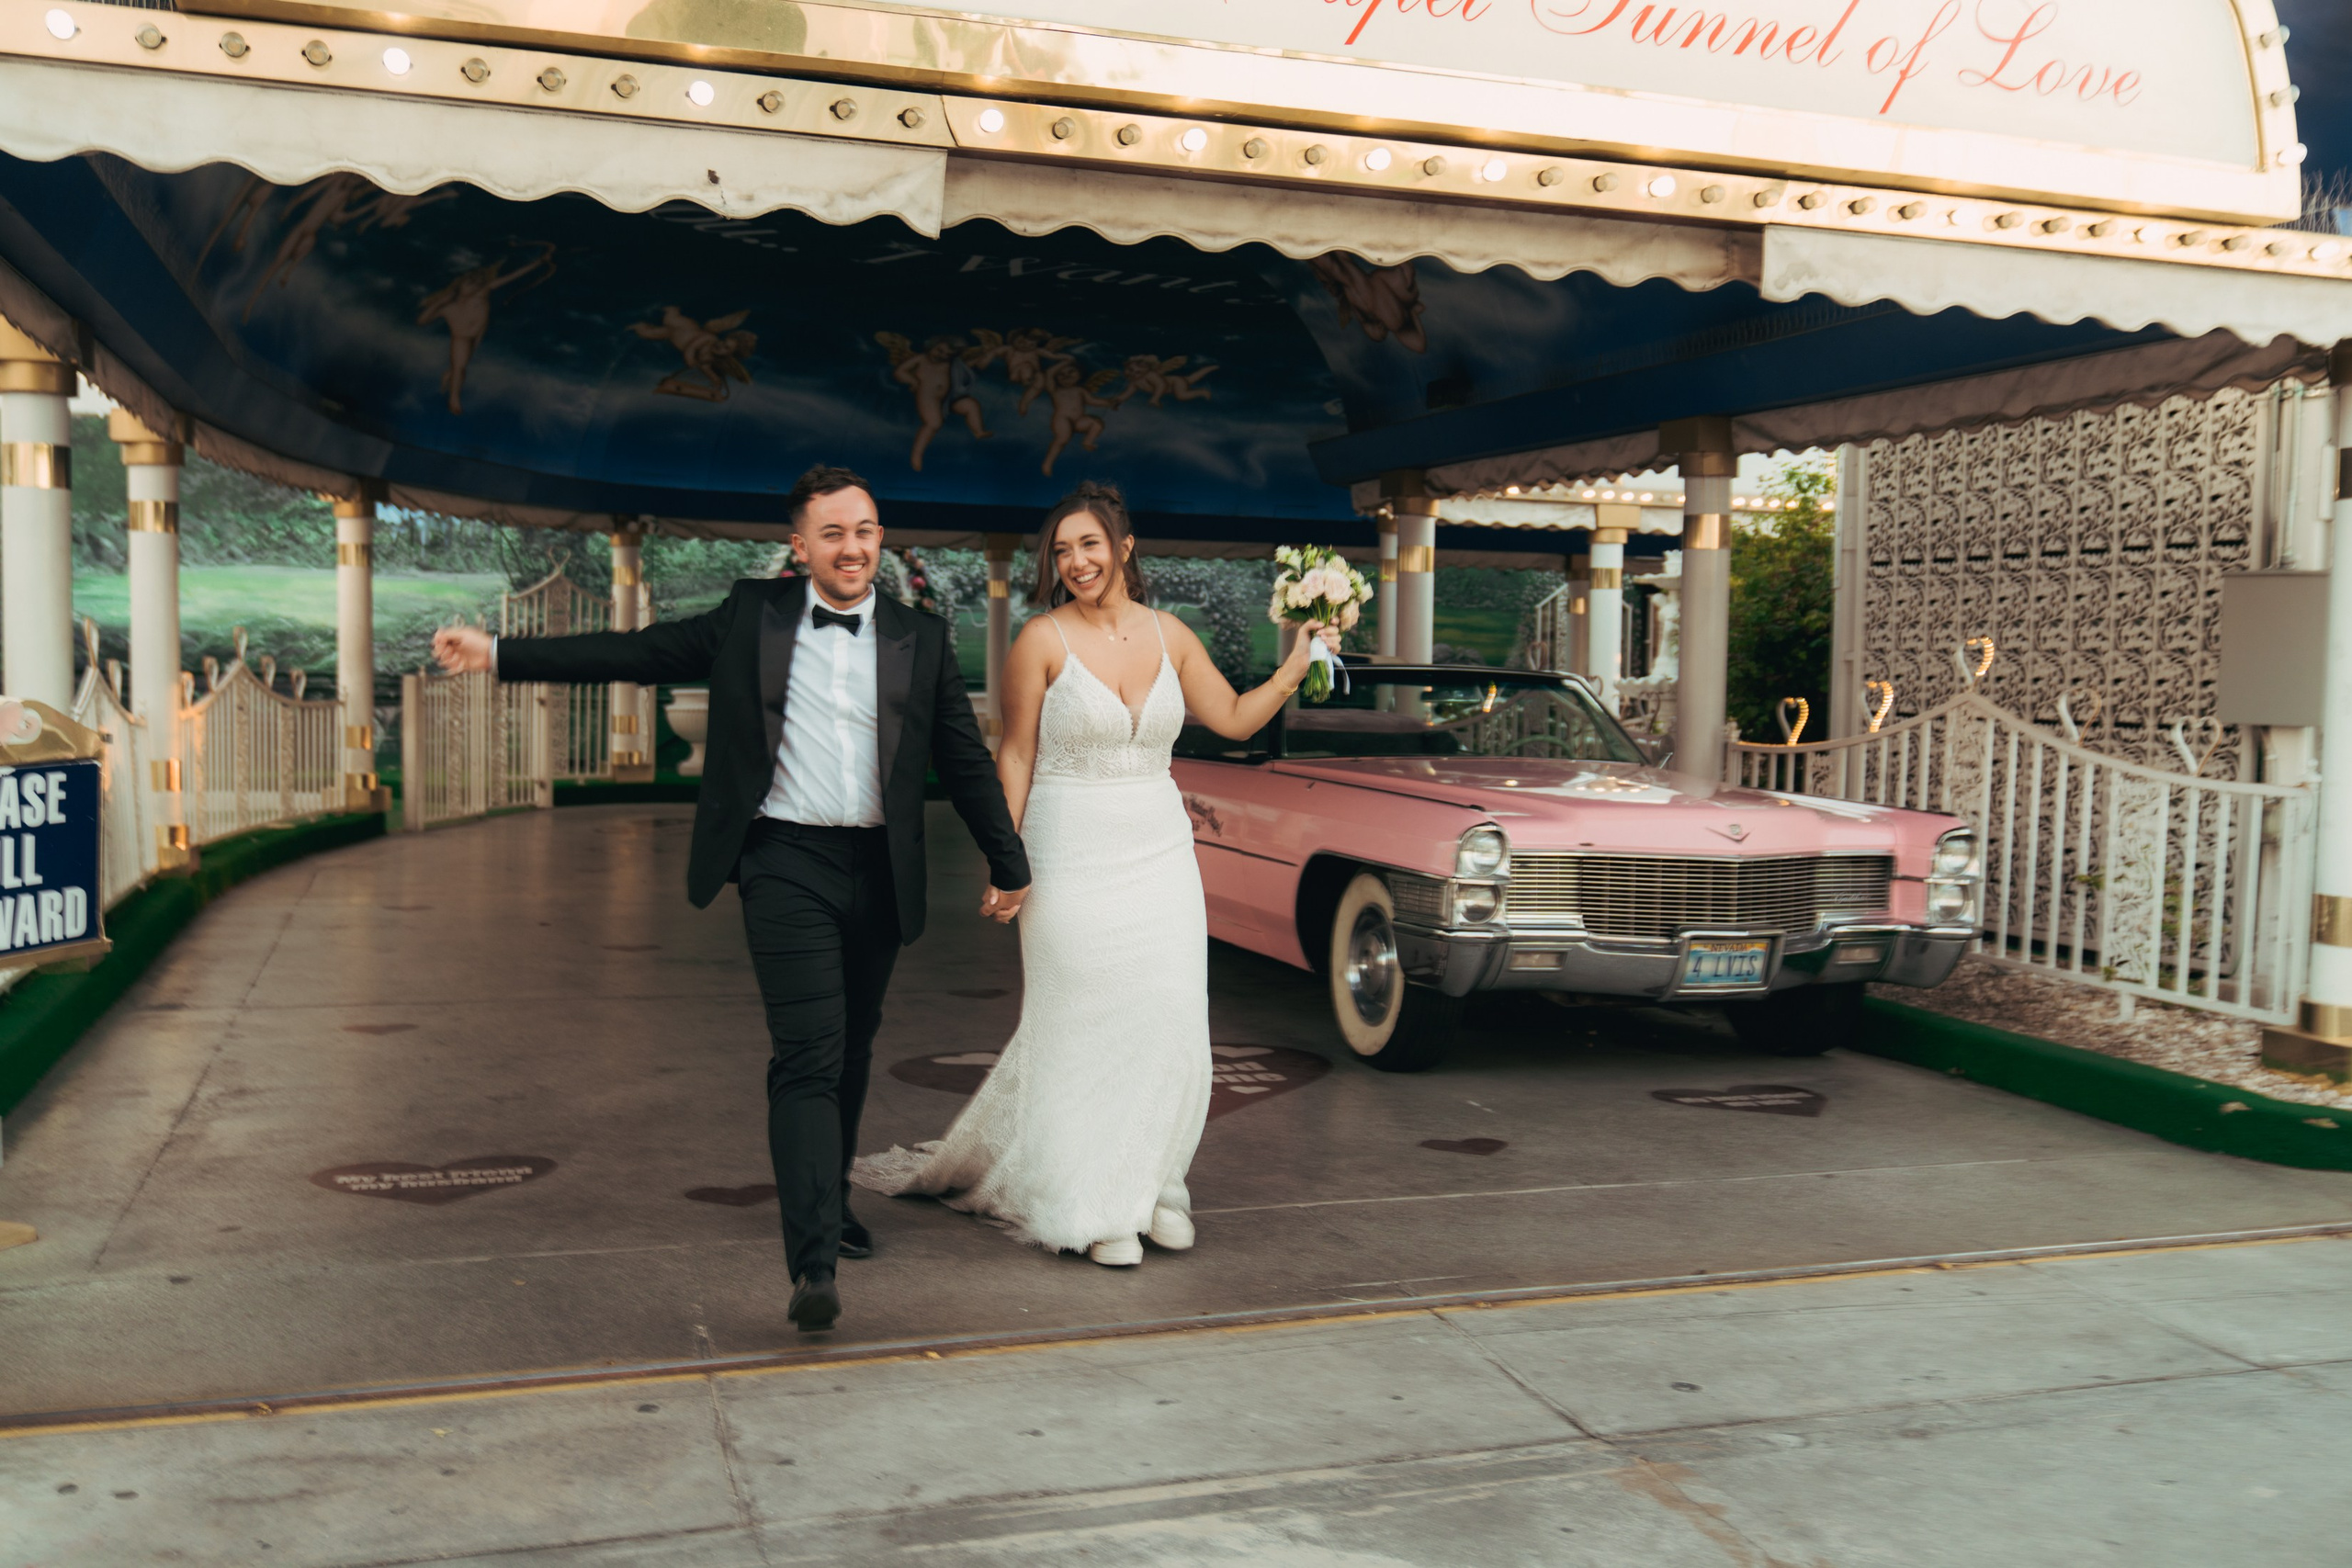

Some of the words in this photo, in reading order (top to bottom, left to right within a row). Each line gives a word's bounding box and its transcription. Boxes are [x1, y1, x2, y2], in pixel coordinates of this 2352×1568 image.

[1866, 0, 1962, 114] of
[1958, 1, 2143, 107] Love
[959, 254, 1238, 293] Want
[1711, 942, 1747, 953] NEVADA
[1692, 956, 1703, 977] 4
[1713, 955, 1758, 977] LVIS
